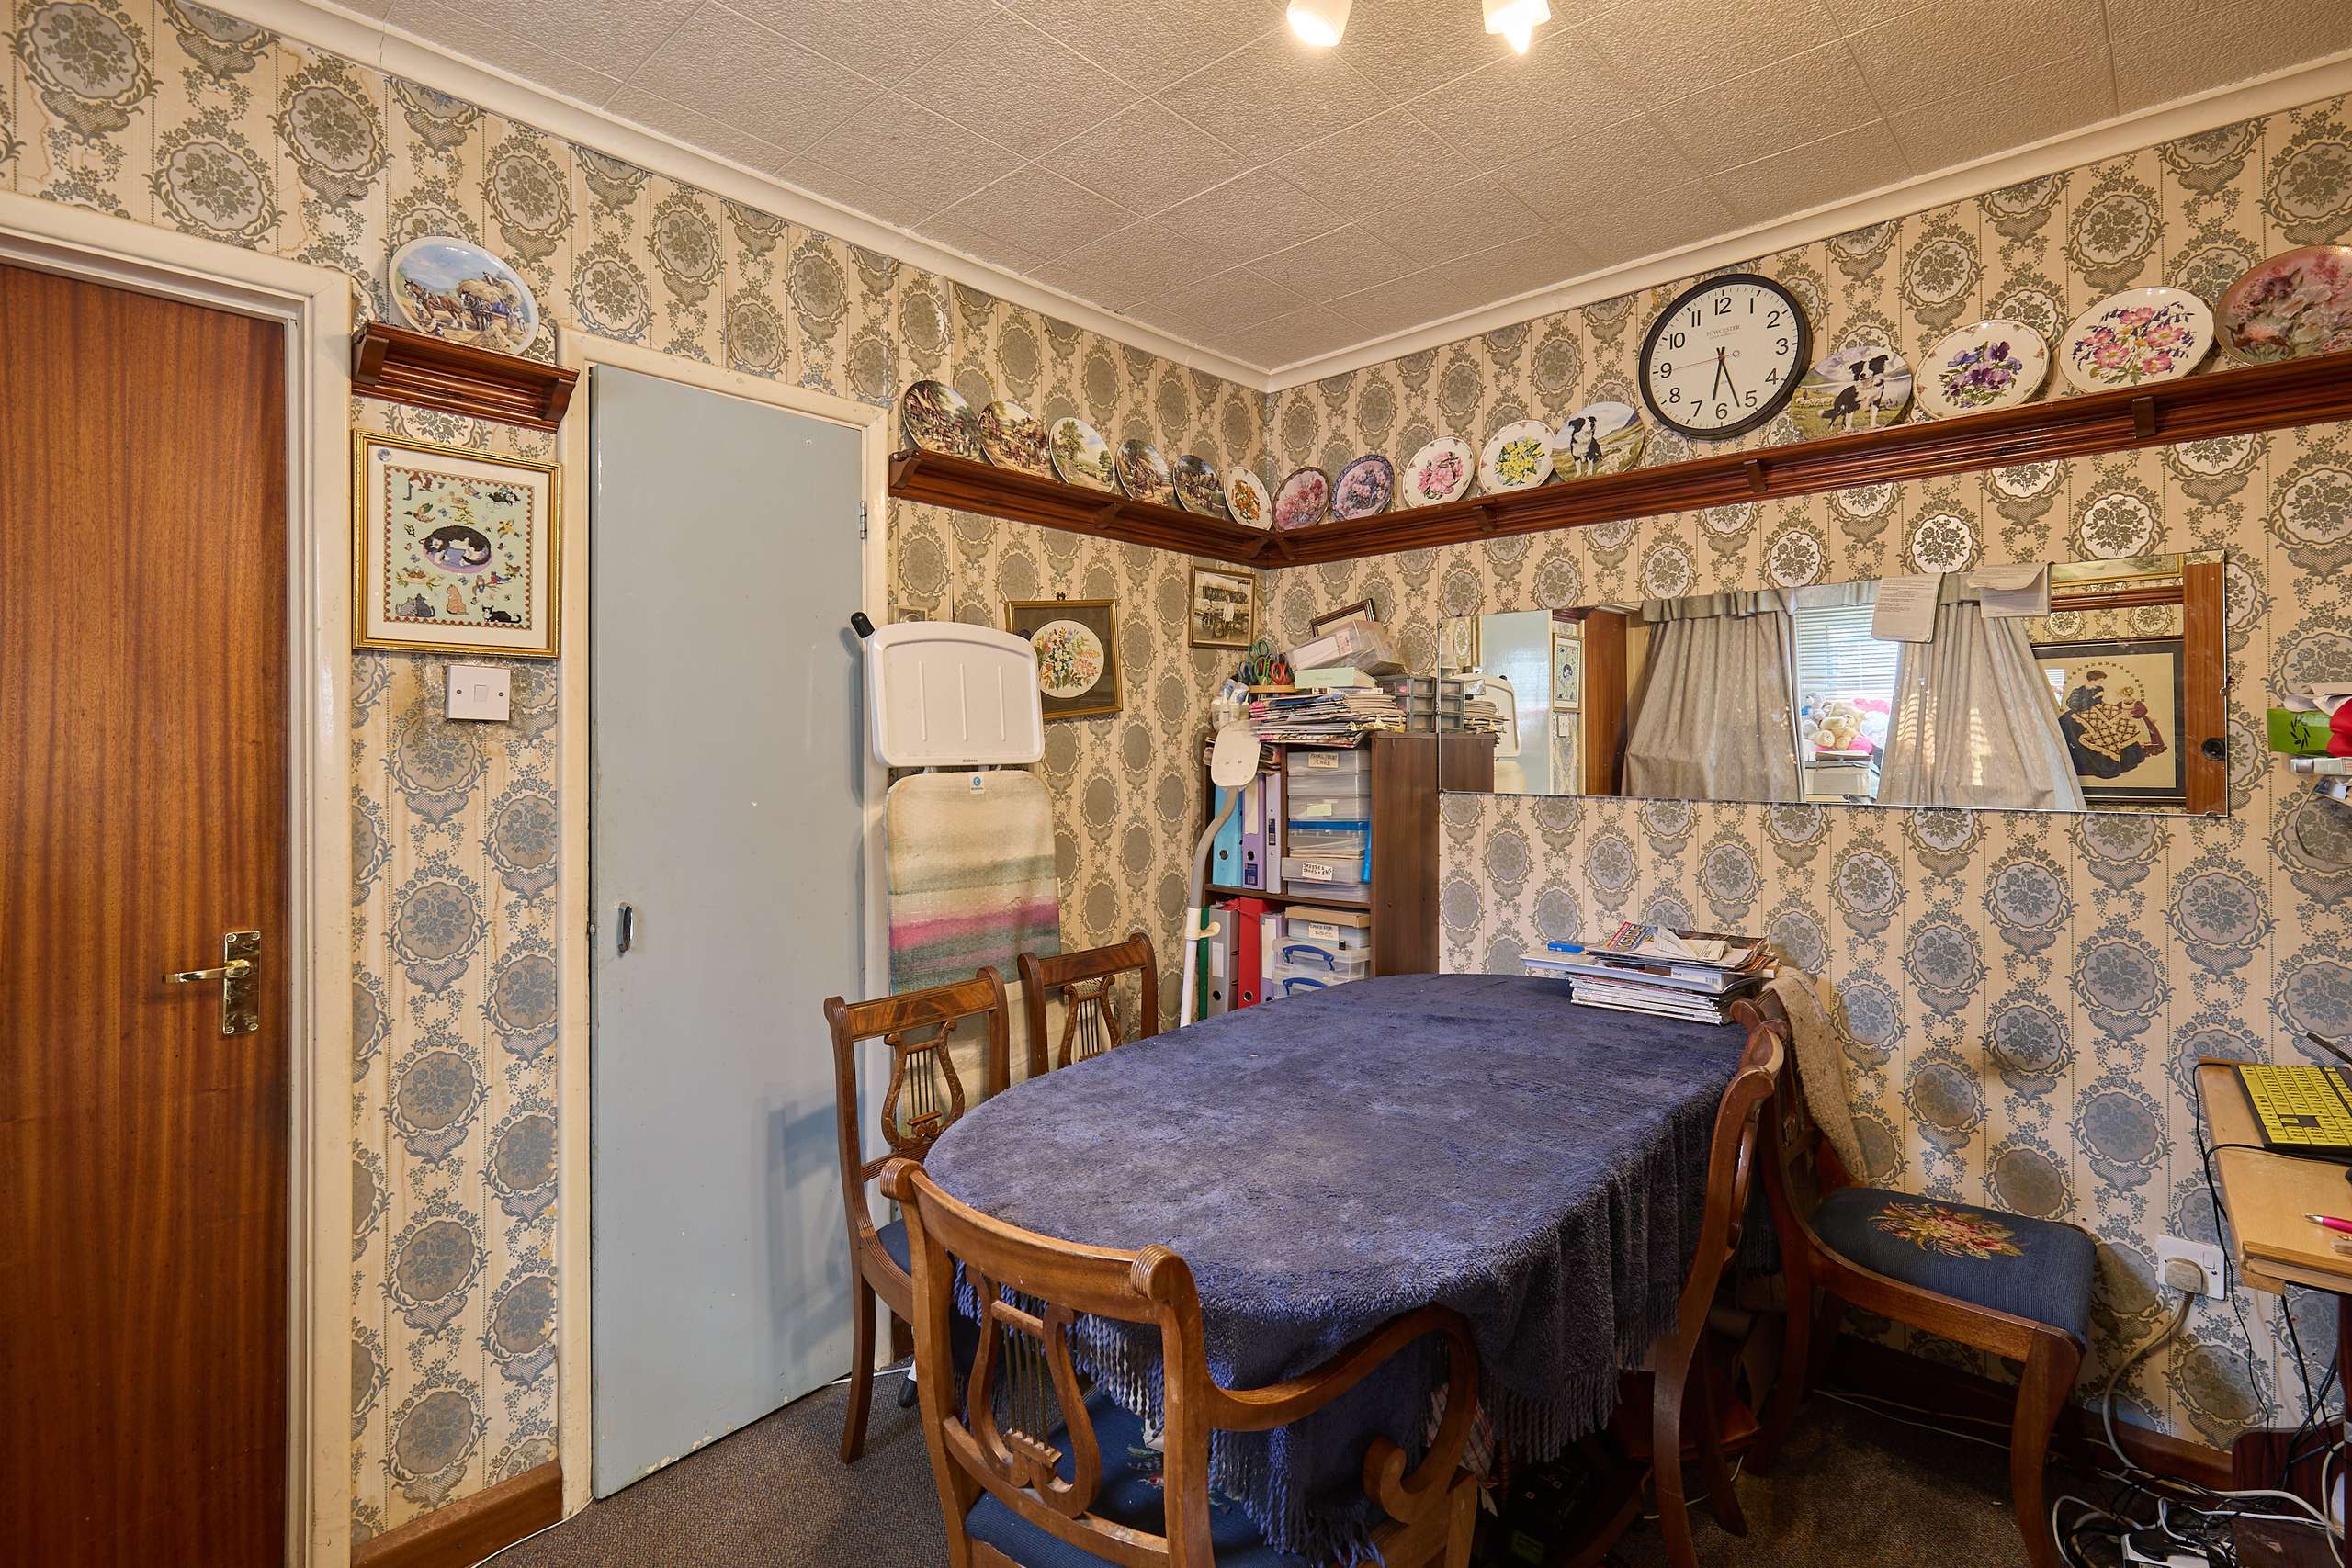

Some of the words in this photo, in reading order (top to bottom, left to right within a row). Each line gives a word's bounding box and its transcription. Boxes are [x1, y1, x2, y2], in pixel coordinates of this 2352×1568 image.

[1714, 297, 1732, 316] 12
[1749, 297, 1754, 314] 1
[1691, 310, 1702, 328] 11
[1766, 310, 1781, 329] 2
[1669, 332, 1686, 350] 10
[1775, 337, 1789, 355] 3
[1660, 362, 1672, 378] 9
[1765, 367, 1779, 385] 4
[1669, 387, 1680, 404] 8
[1745, 389, 1758, 408] 5
[1690, 400, 1702, 418] 7
[1715, 402, 1728, 420] 6
